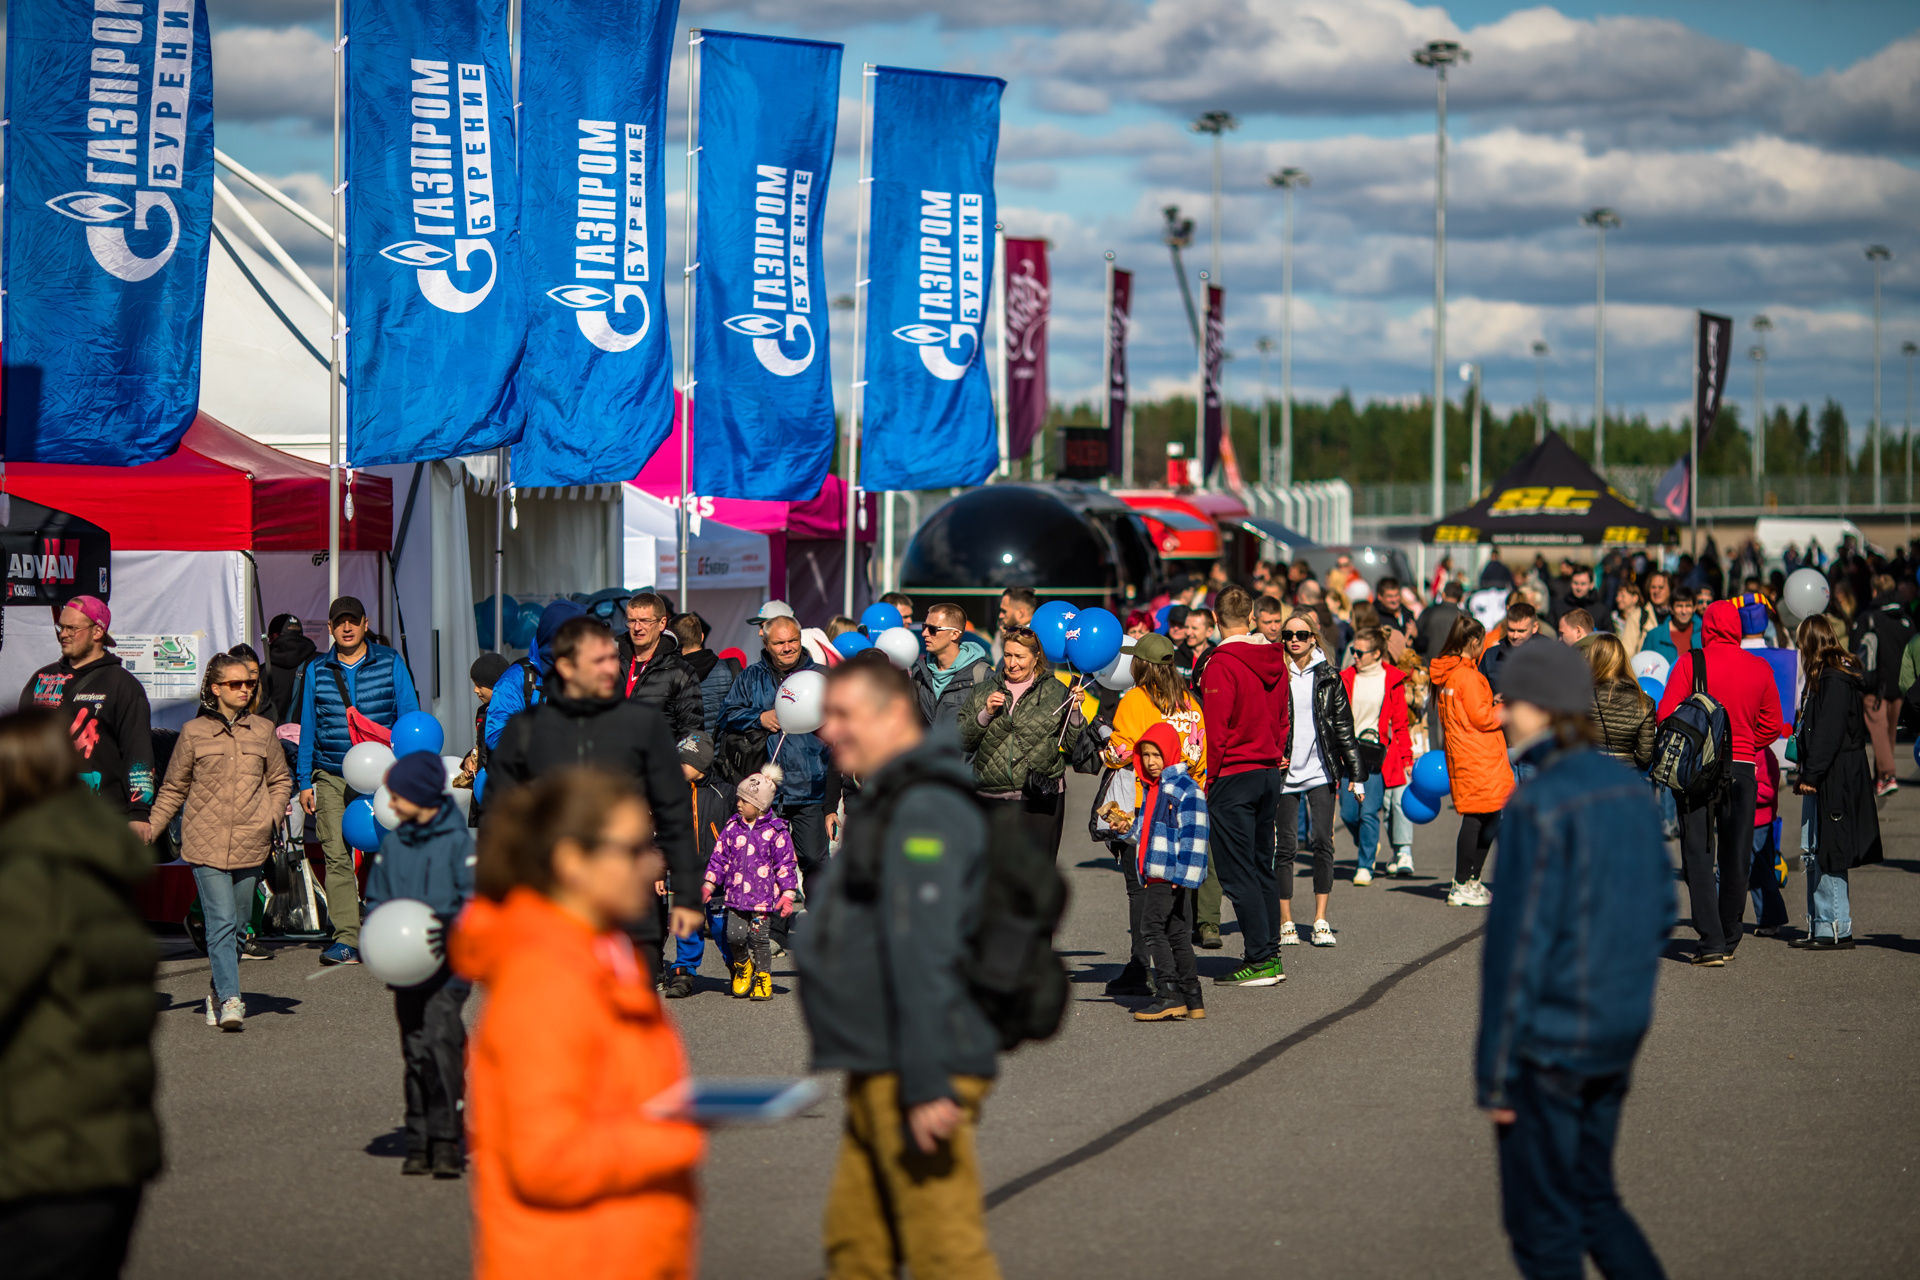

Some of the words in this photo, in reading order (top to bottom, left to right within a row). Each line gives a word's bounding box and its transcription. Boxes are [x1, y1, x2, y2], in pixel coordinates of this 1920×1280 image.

[153, 0, 189, 181] БУРЕНИ
[411, 58, 455, 235] ГАЗПРОМ
[461, 67, 491, 230] БУРЕНИЕ
[575, 119, 617, 280] ГАЗПРОМ
[627, 127, 645, 277] БУРЕНИЕ
[753, 165, 787, 311] ГАЗПРОМ
[793, 173, 809, 309] БУРЕНИЕ
[919, 190, 952, 321] ГАЗПРОМ
[963, 197, 979, 319] БУРЕНИЕ
[7, 553, 74, 579] ADVAN
